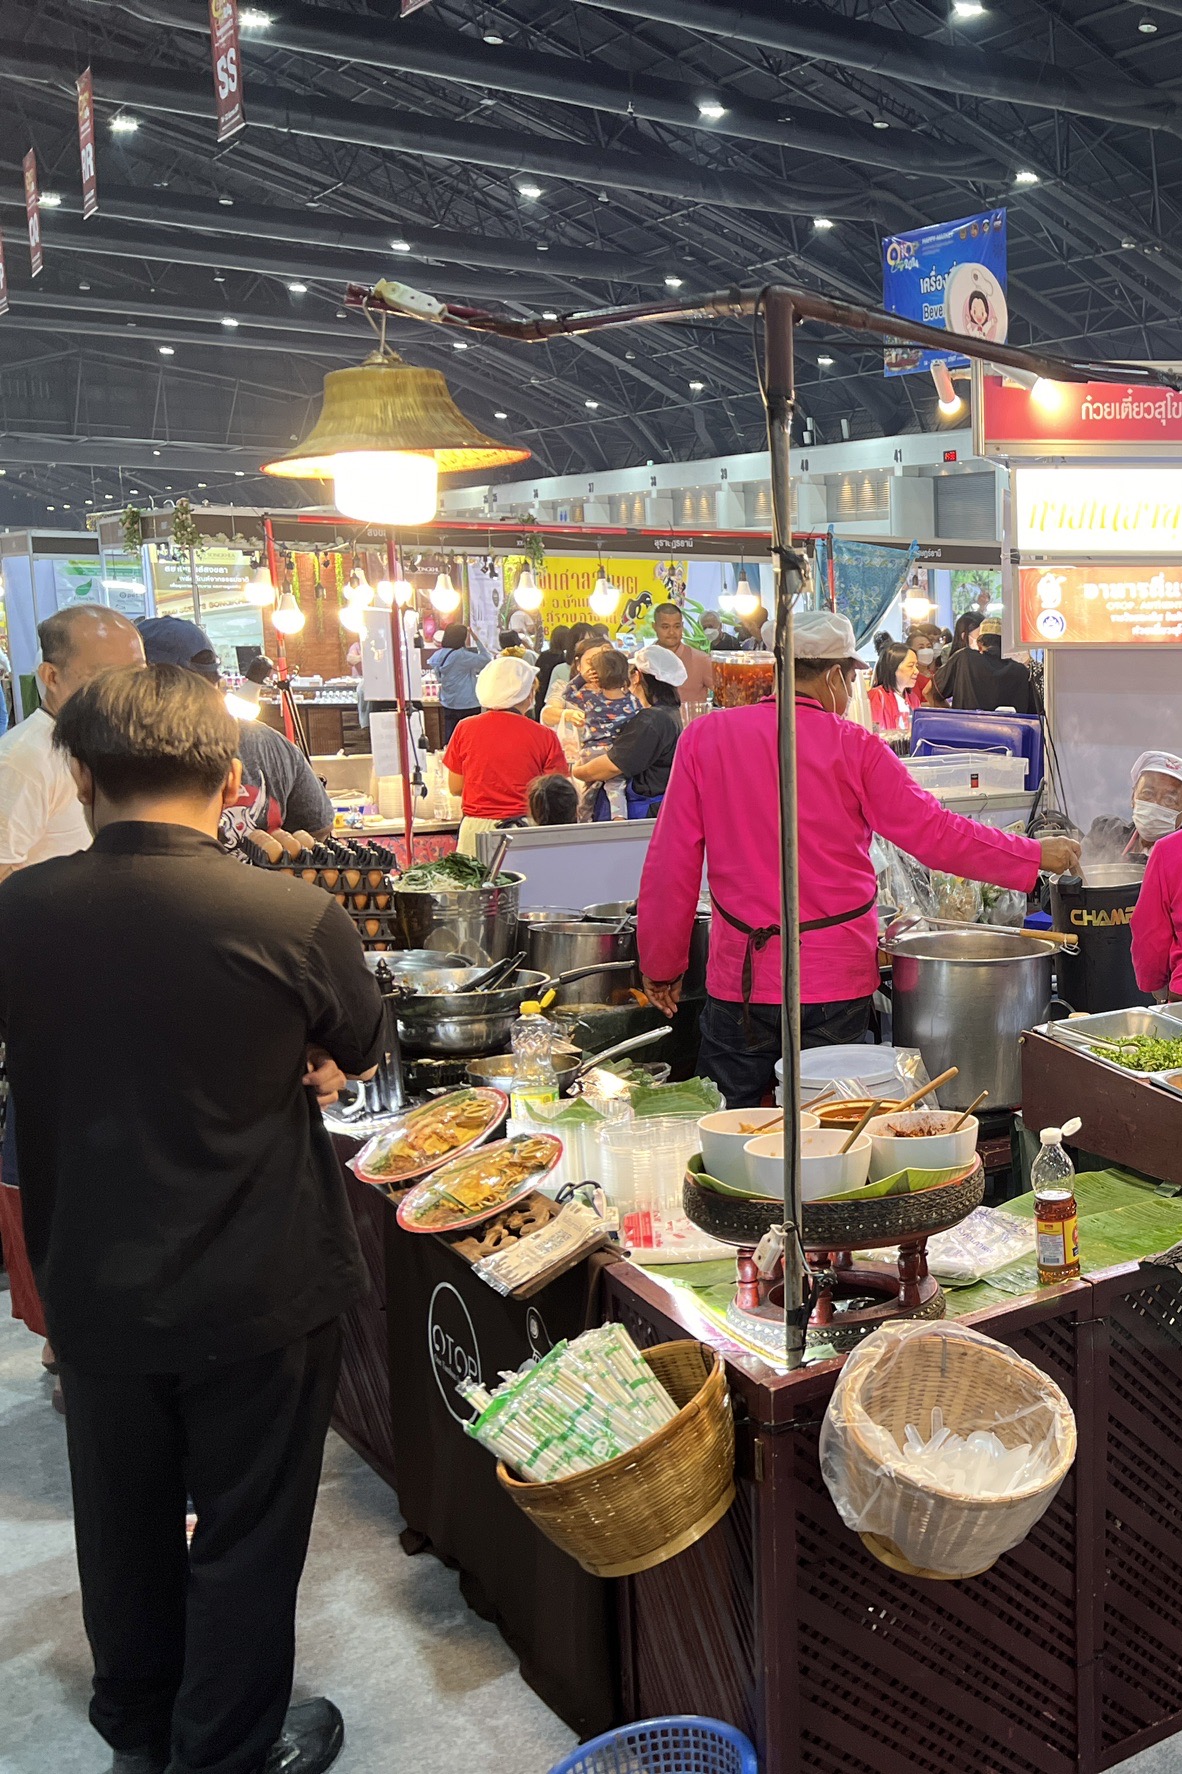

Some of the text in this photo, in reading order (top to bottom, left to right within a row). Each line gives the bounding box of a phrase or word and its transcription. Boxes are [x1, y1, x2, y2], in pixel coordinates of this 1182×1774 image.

[216, 47, 238, 99] SS
[800, 459, 809, 472] 40
[893, 449, 902, 463] 41
[432, 1324, 478, 1377] OTOP
